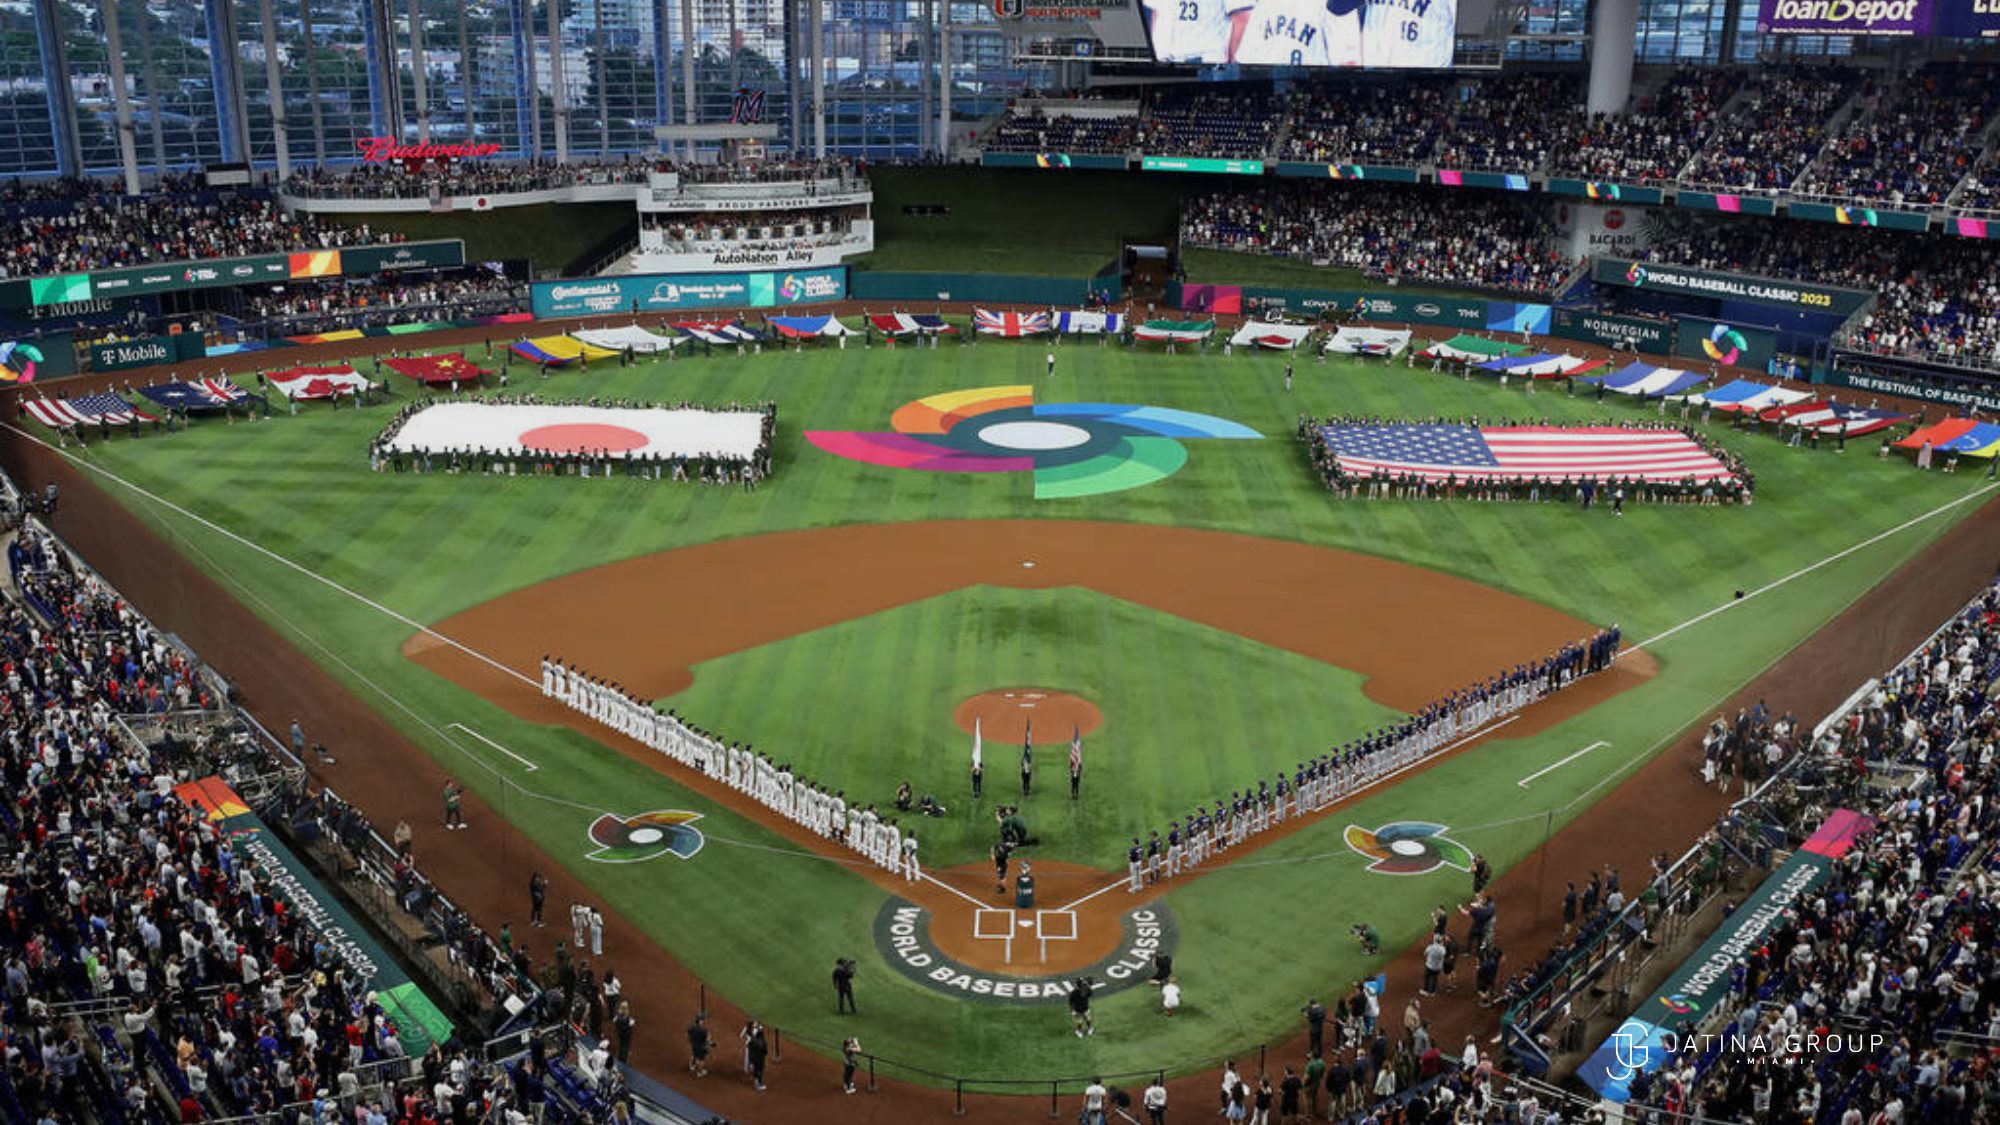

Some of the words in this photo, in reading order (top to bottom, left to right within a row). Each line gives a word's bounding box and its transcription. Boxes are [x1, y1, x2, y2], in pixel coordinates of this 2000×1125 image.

[1178, 1, 1199, 21] 23
[1400, 20, 1419, 43] 16
[357, 136, 501, 163] Budweiser
[717, 201, 755, 209] PROUD
[759, 199, 810, 208] PARTNERS
[713, 252, 778, 265] AutoNation
[785, 249, 813, 263] Alley
[1647, 272, 1688, 287] WORLD
[1688, 277, 1746, 295] BASEBALL
[1748, 285, 1799, 302] CLASSIC
[1800, 293, 1831, 307] 2023
[1583, 318, 1660, 340] NORWEGIAN
[118, 344, 167, 363] Mobile
[1848, 375, 1871, 388] THE
[1870, 377, 1923, 397] FESTIVAL
[1925, 388, 1942, 399] OF
[1680, 953, 1733, 996] WORLD
[1720, 903, 1784, 956] BASEBALL
[1771, 864, 1819, 904] CLASSIC
[890, 907, 932, 967] WORLD
[1107, 910, 1161, 978] CLASSIC
